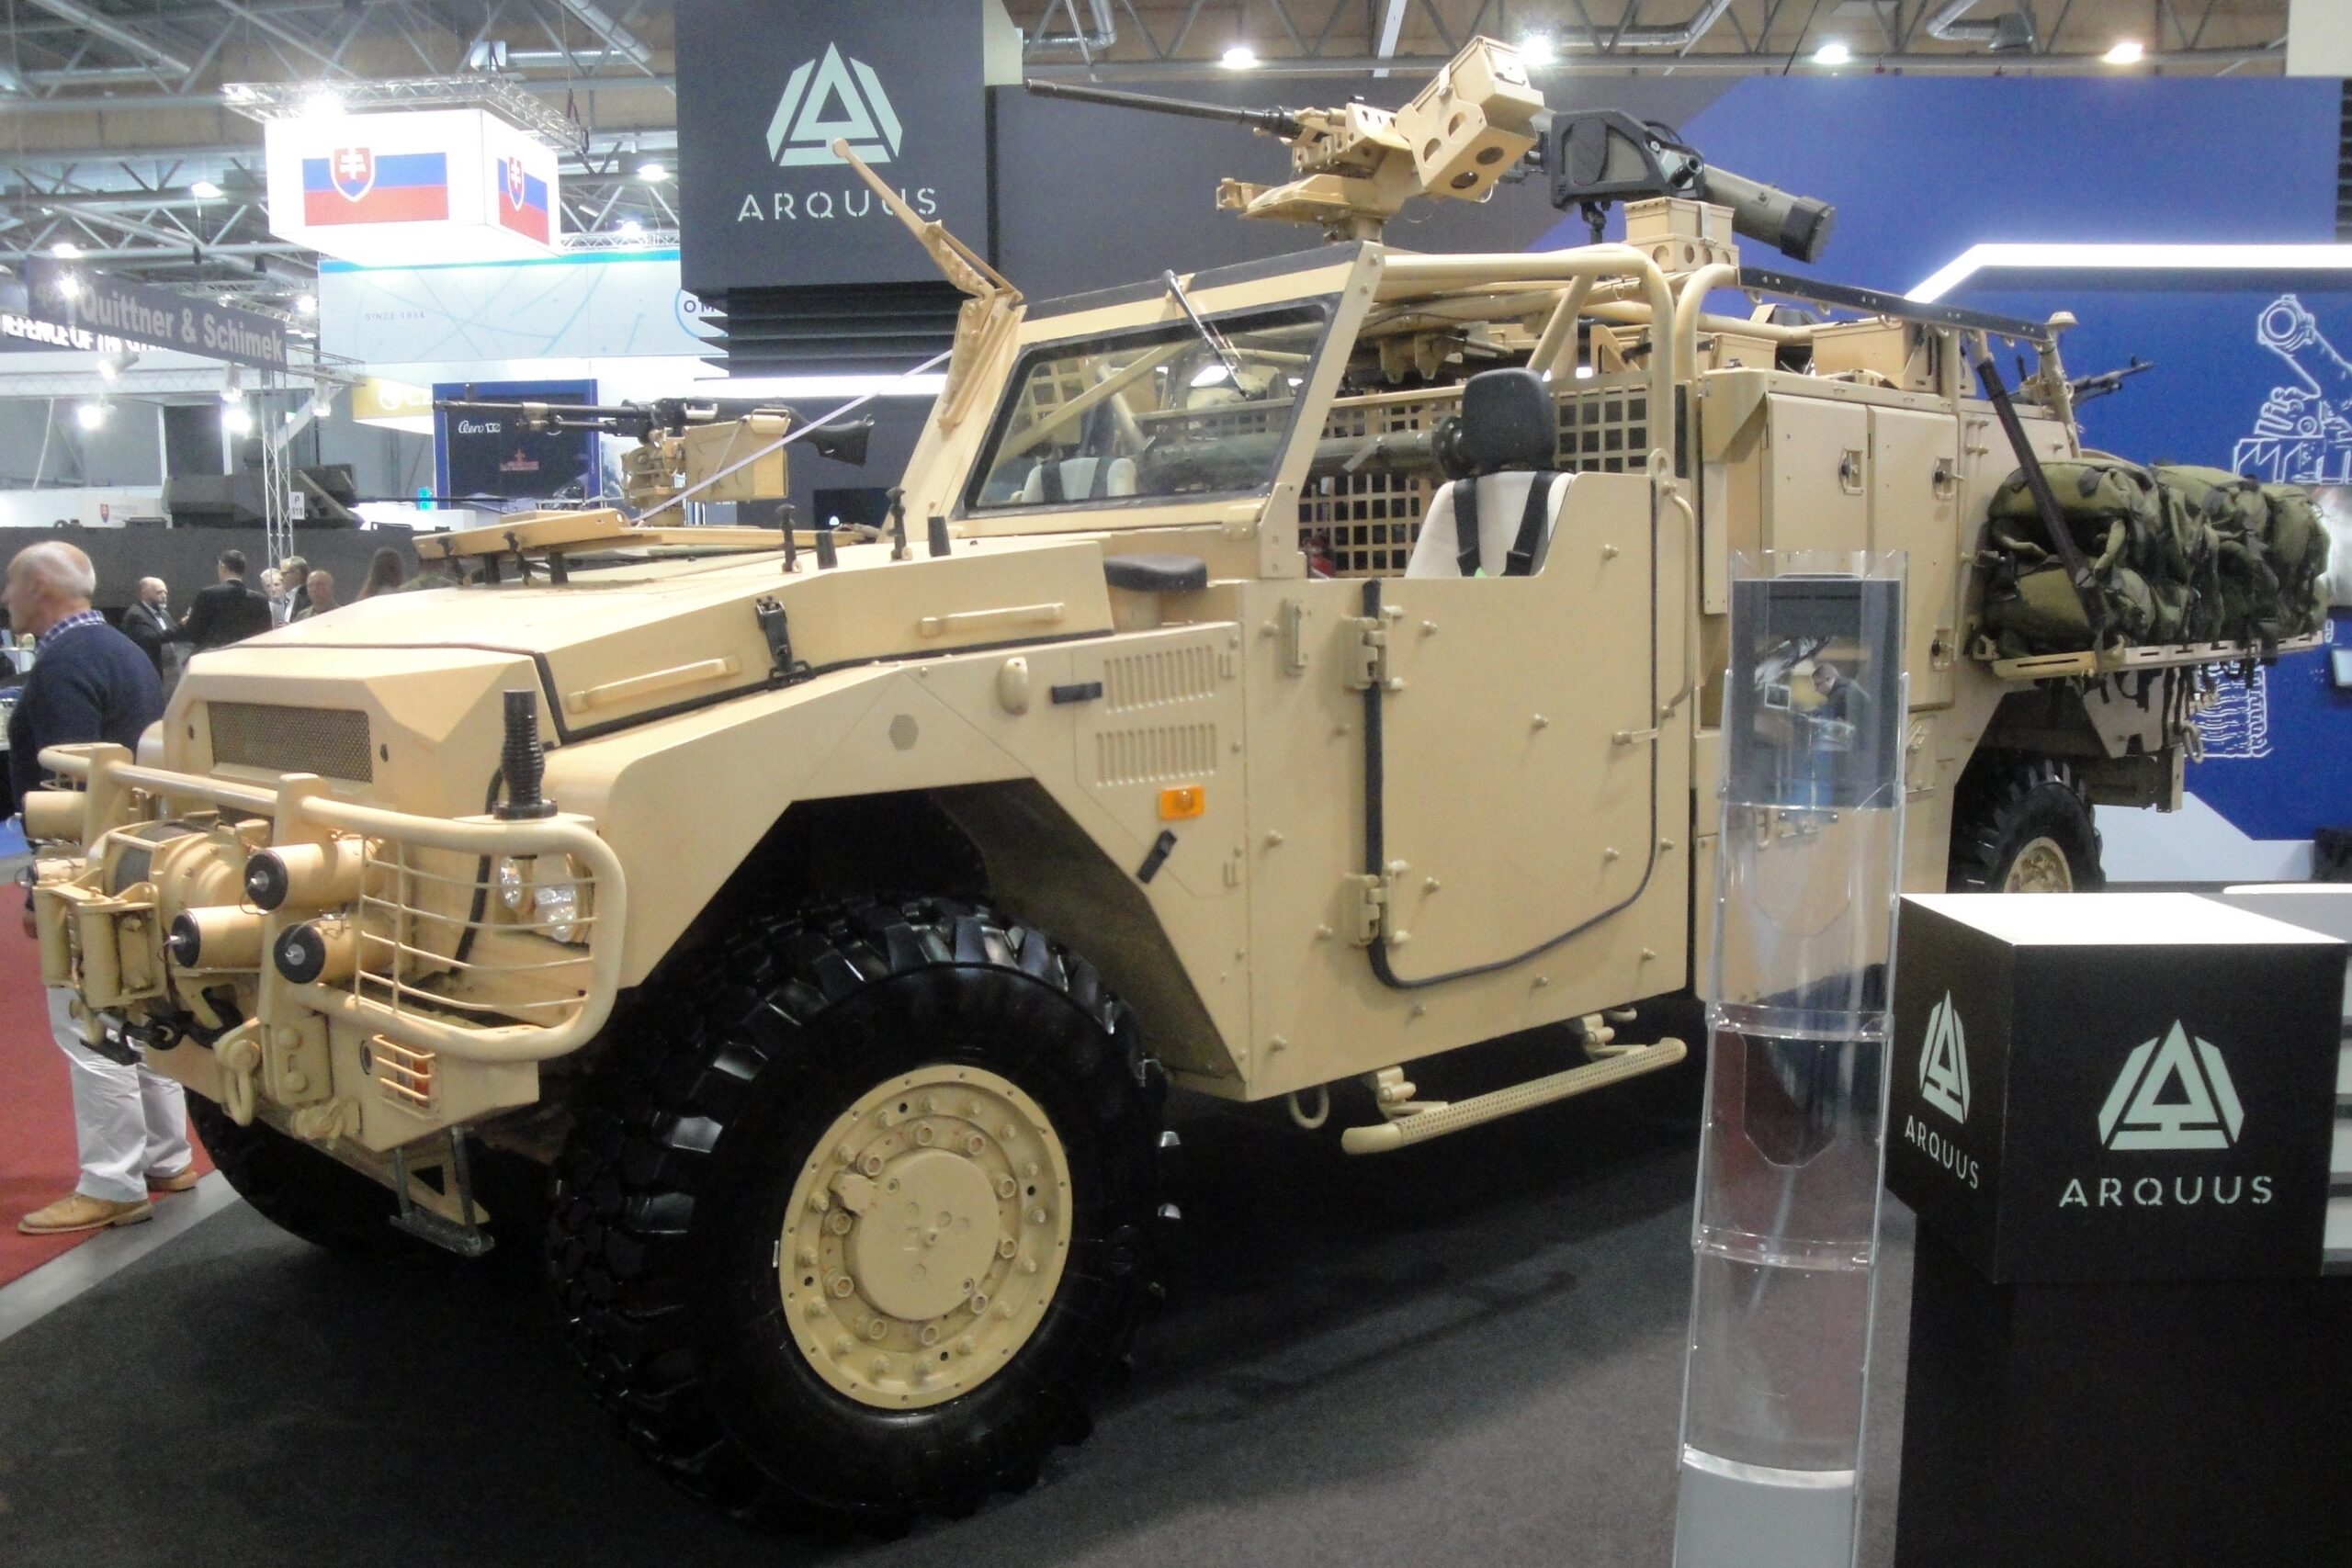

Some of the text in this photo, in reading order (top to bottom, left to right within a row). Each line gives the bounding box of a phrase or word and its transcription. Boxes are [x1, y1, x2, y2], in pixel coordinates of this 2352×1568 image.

[80, 288, 284, 363] Quittner & Schimek
[365, 311, 395, 321] SINCE
[1905, 1115, 1979, 1190] ARQUUS
[2059, 1176, 2274, 1208] ARQUUS
